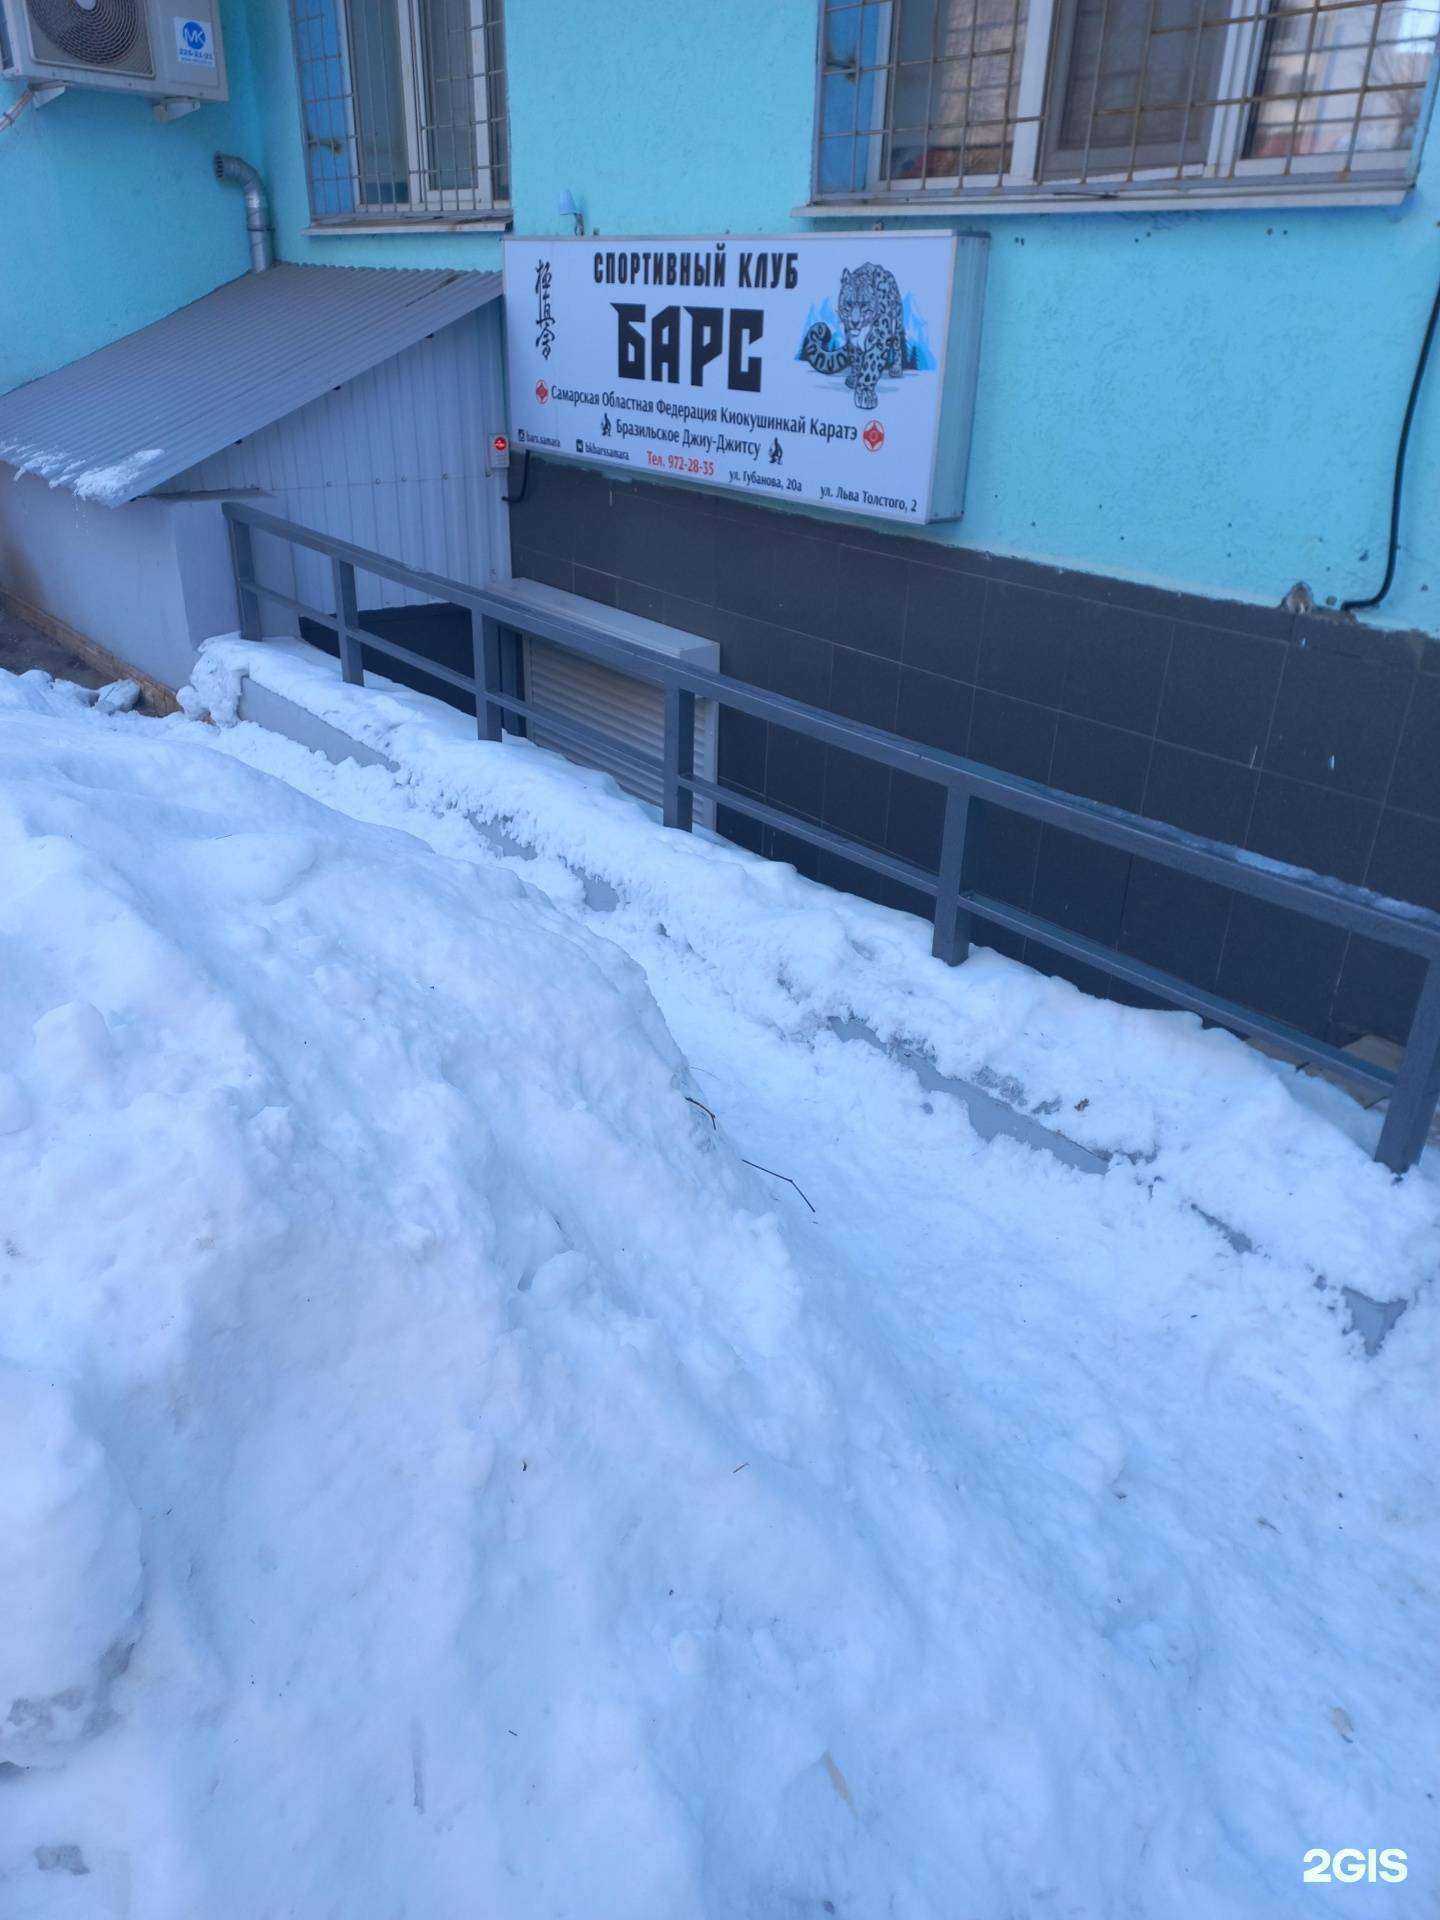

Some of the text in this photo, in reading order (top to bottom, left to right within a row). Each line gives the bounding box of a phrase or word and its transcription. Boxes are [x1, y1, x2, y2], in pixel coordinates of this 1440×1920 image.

[594, 243, 799, 290] СПОРТИВНЫЙ КЛУБ
[609, 302, 765, 393] БАРС
[551, 385, 858, 443] Самарская Областная Федерация Киокушинкай Каратэ
[616, 419, 762, 461] Бразильское Джиу-Джитсу
[646, 450, 715, 476] Тел. 972-28-35
[729, 470, 803, 492] ул. Губанова, 20а
[820, 486, 918, 513] ул. Льва Толстого, 2
